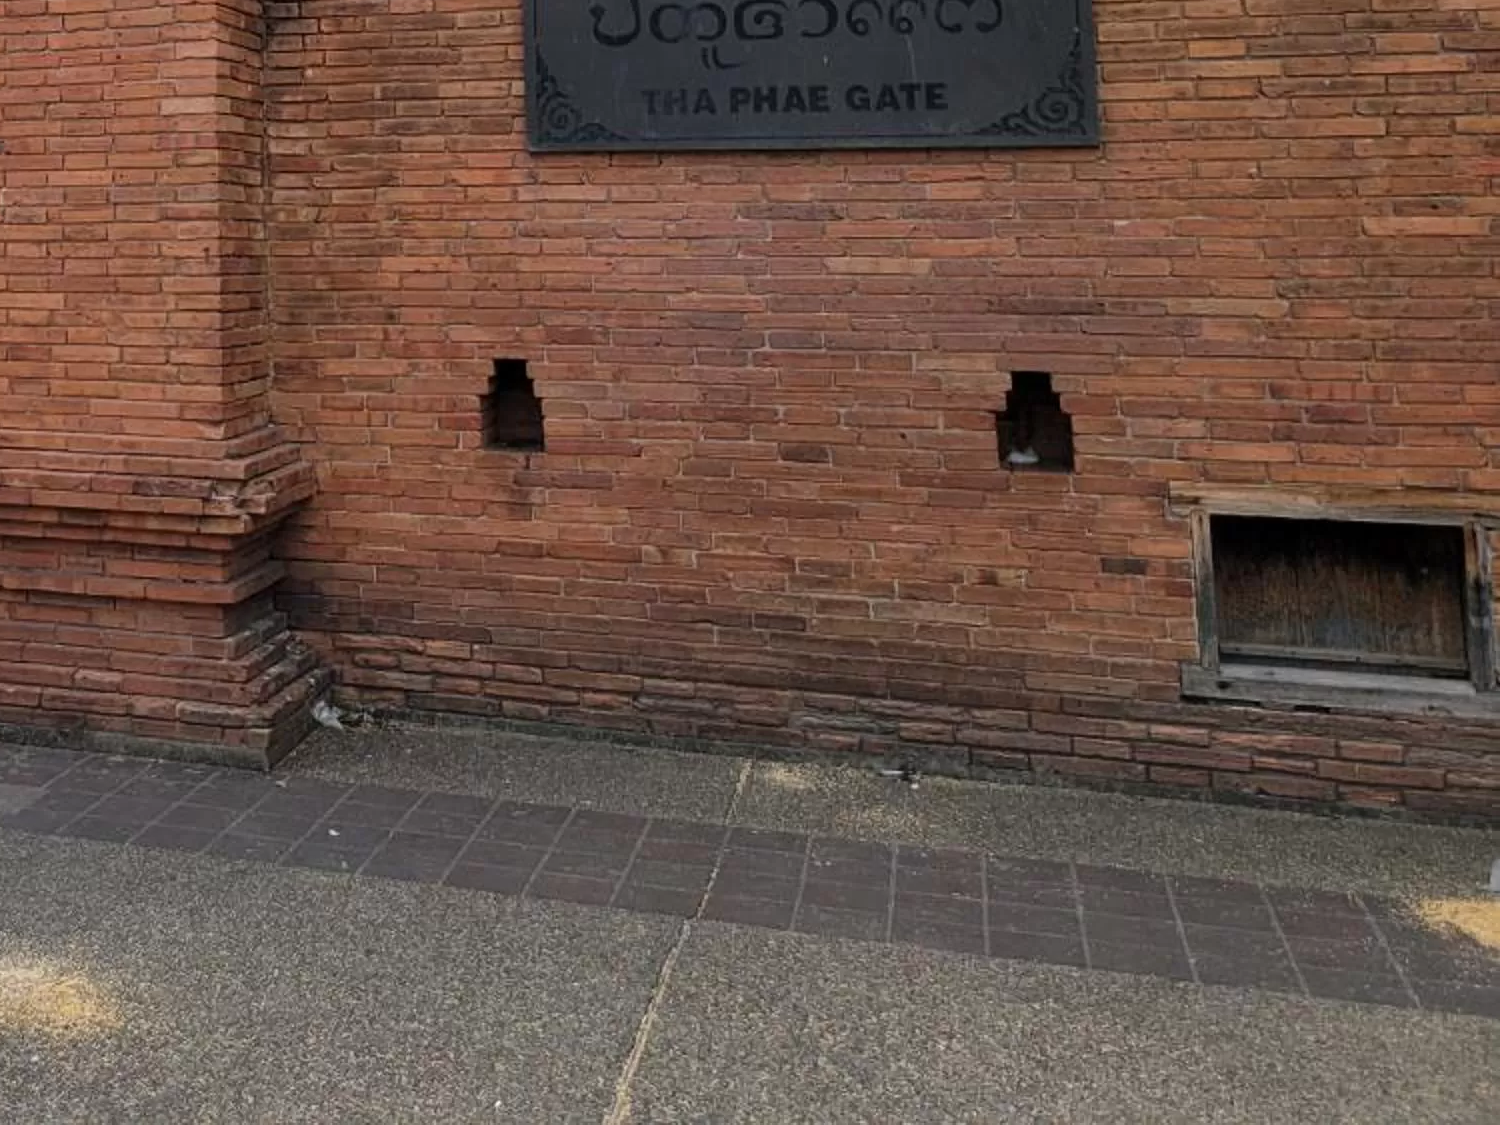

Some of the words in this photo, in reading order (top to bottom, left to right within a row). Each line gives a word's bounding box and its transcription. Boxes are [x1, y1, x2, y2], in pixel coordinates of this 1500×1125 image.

[642, 86, 717, 115] THA
[728, 84, 832, 114] PHAE
[844, 81, 948, 112] GATE
